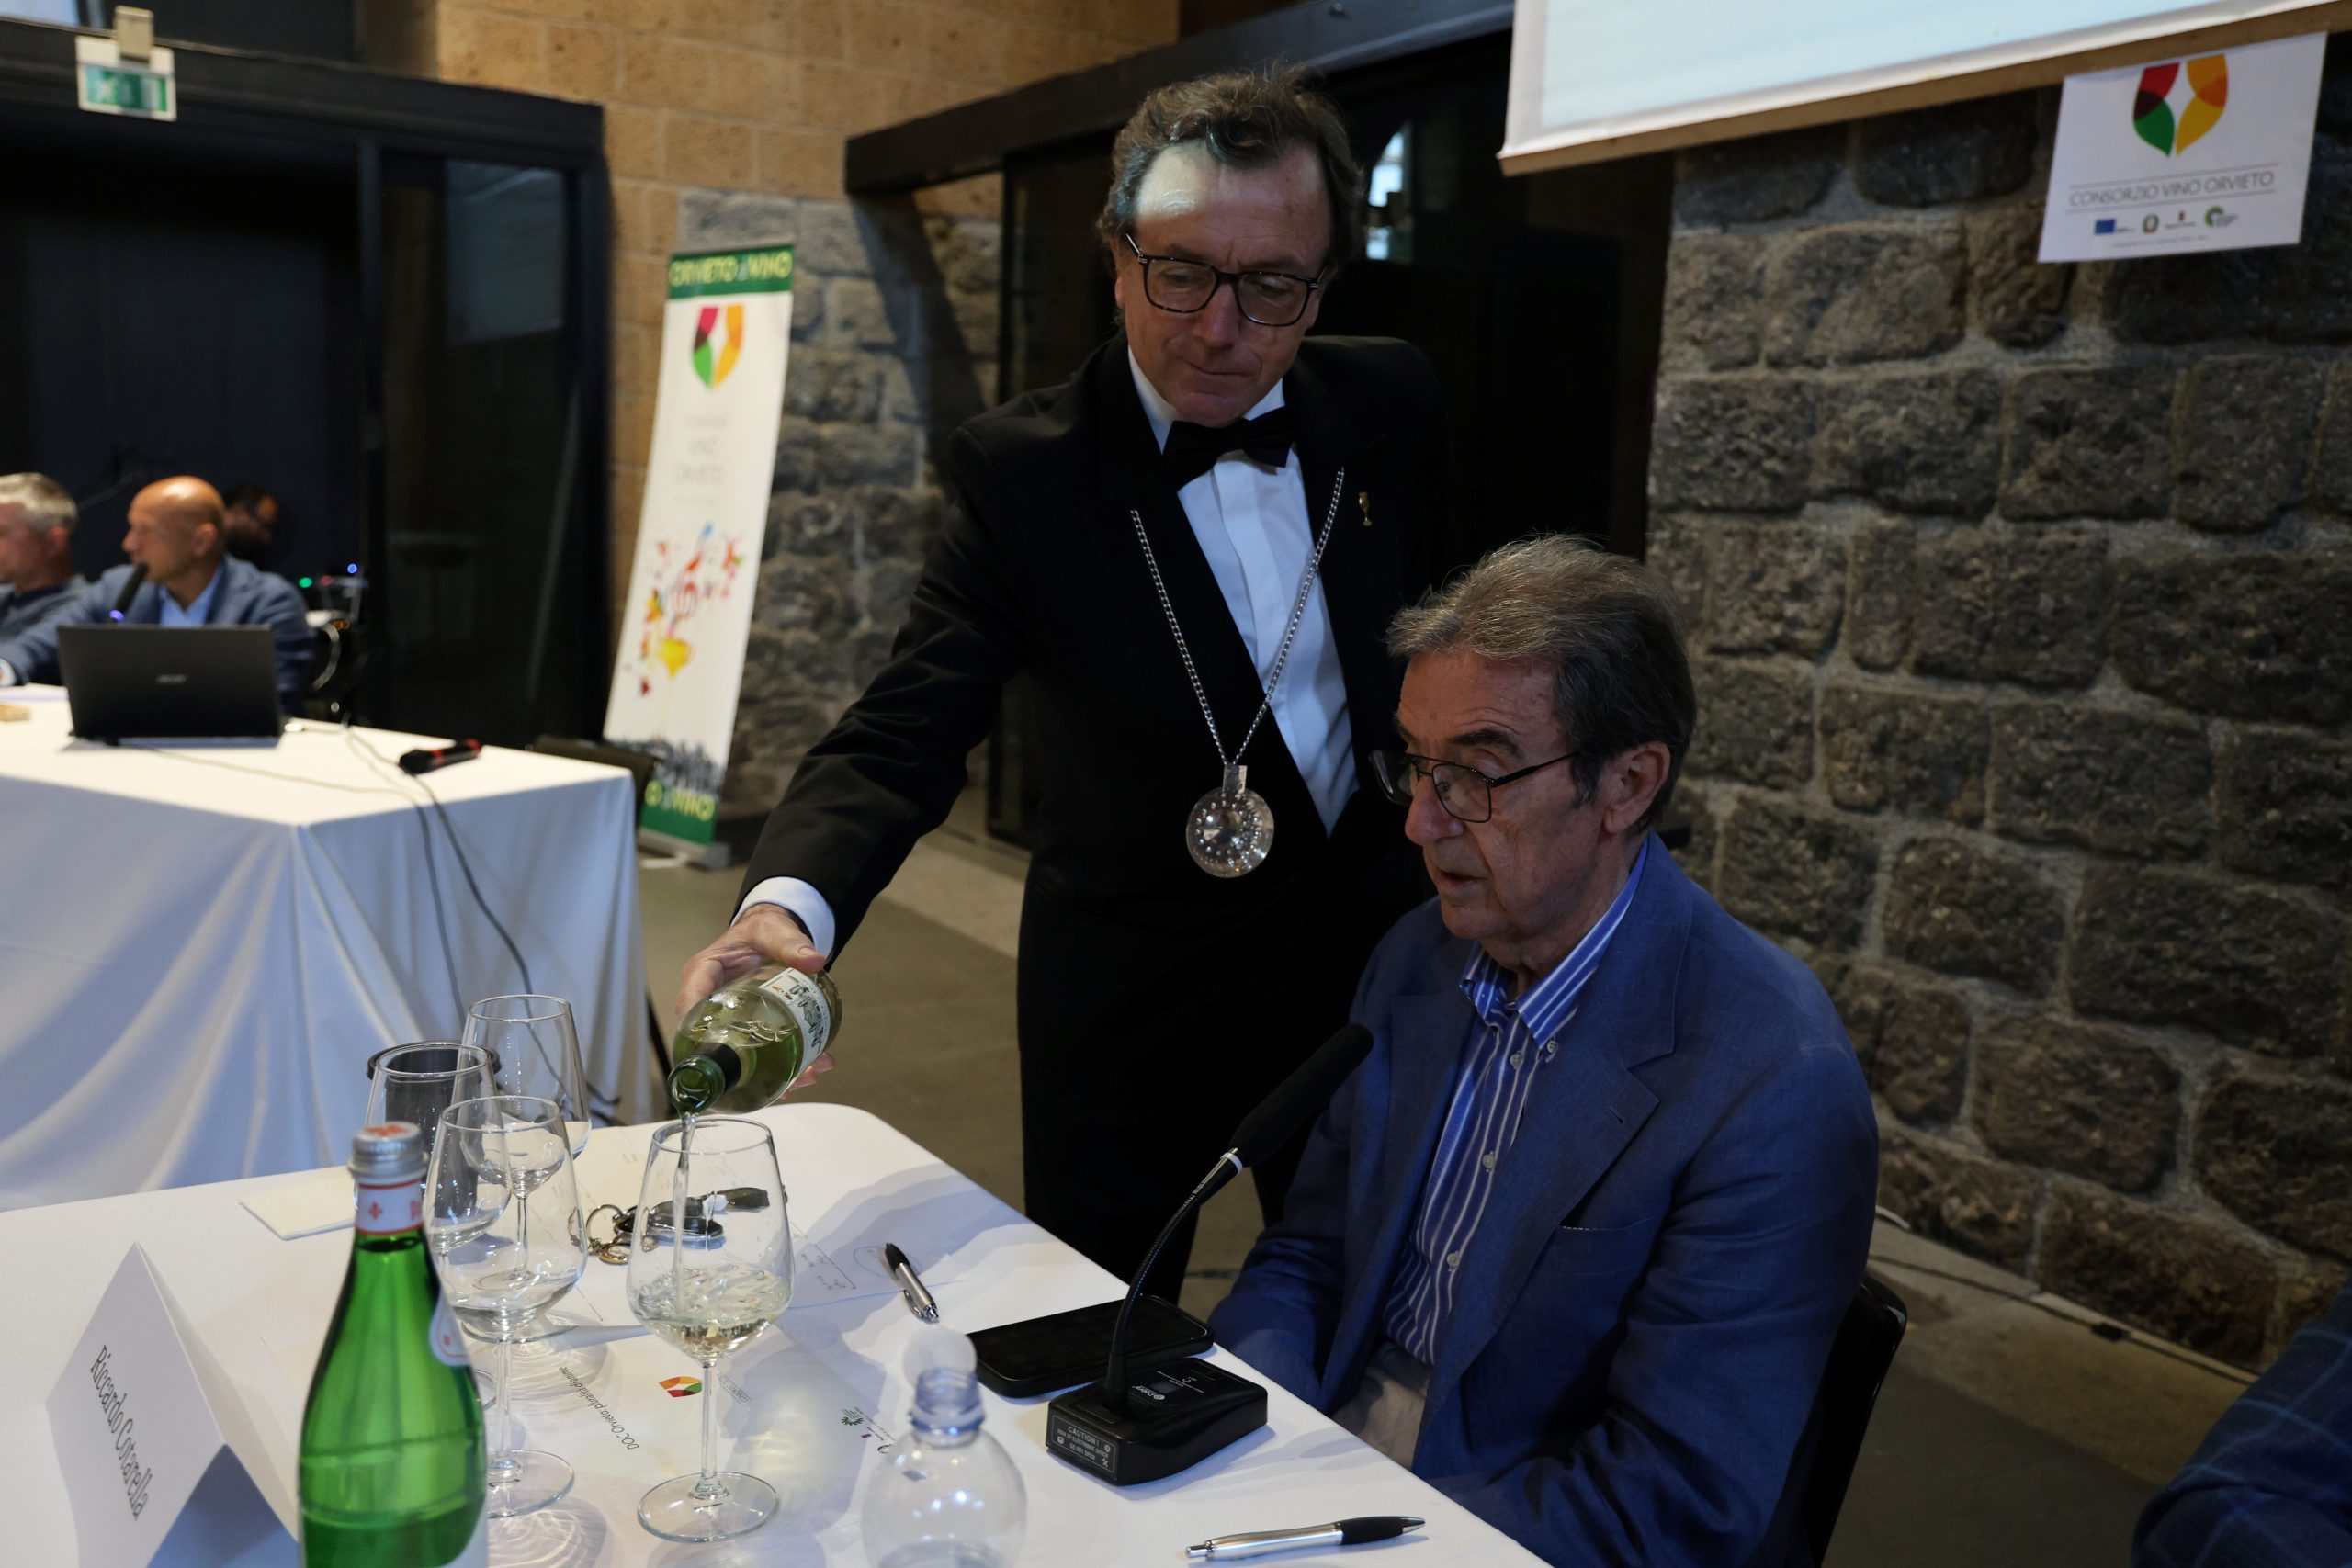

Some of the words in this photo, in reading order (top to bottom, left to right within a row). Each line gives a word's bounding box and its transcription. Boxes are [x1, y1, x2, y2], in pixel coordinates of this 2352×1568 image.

[2069, 184, 2158, 207] CONSORZIO
[2162, 177, 2201, 198] VINO
[2204, 171, 2275, 195] ORVIETO
[90, 1344, 128, 1434] Riccardo
[115, 1418, 153, 1521] Cotarella
[616, 1433, 639, 1450] DOC
[1069, 1426, 1096, 1445] CAUTION
